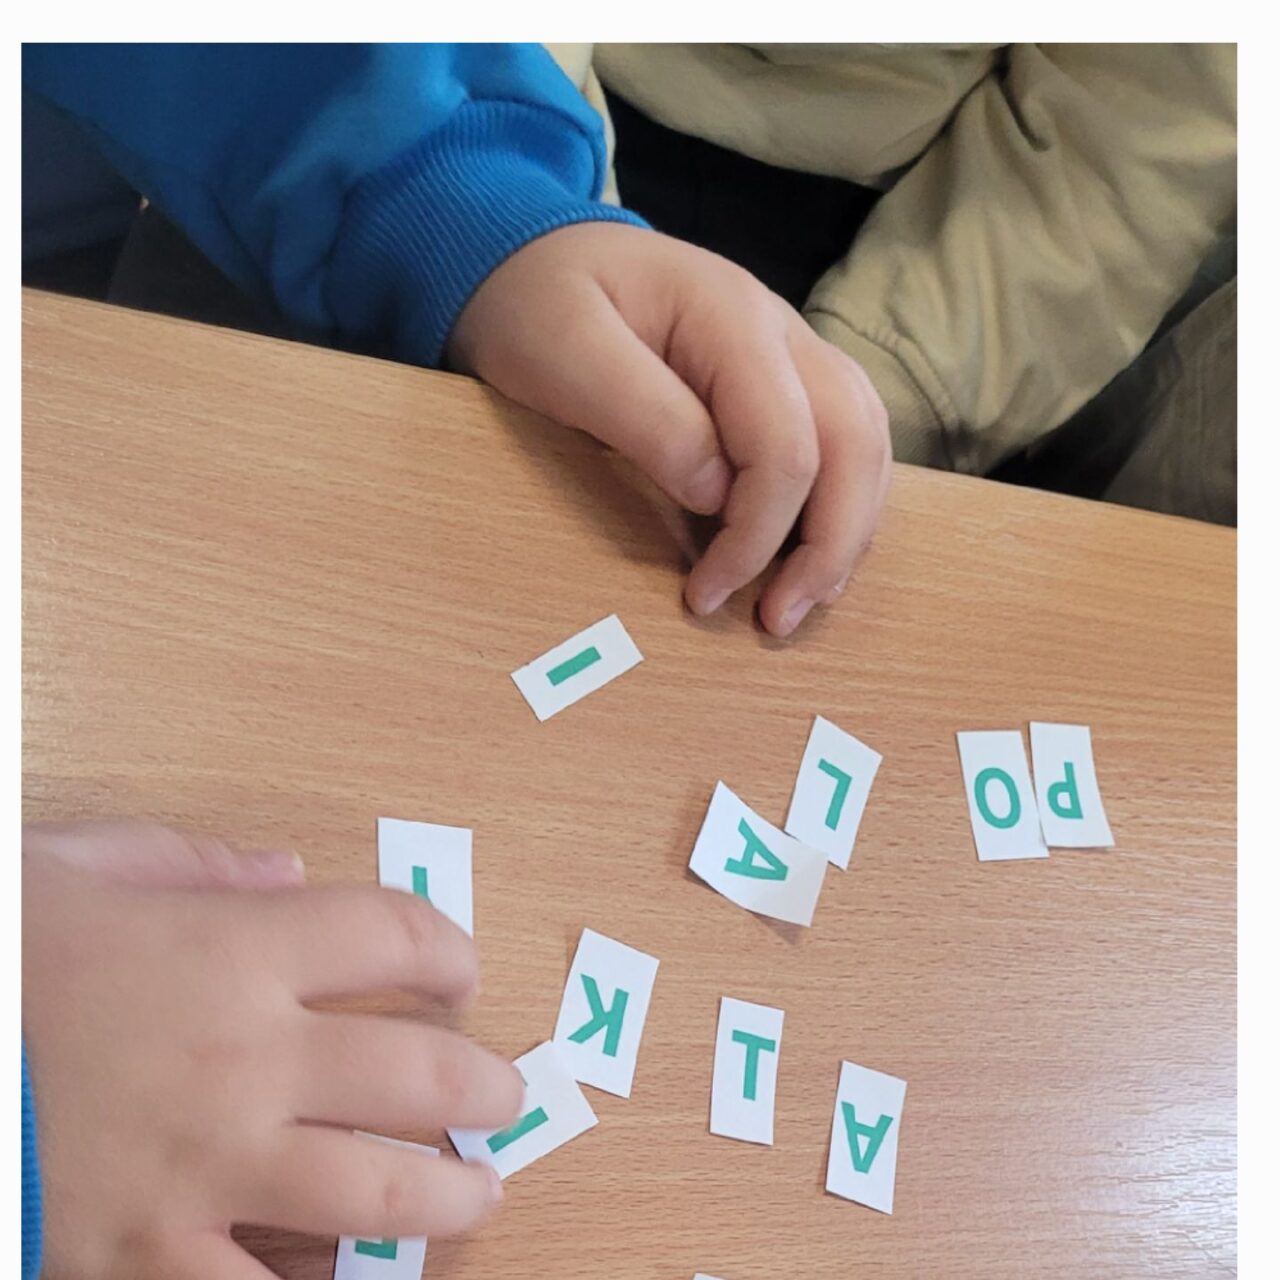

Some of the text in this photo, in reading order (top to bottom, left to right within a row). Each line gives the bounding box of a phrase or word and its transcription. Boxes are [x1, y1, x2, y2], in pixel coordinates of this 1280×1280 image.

[816, 758, 853, 830] L
[723, 817, 789, 882] A
[567, 973, 630, 1057] K
[731, 1029, 775, 1100] T
[840, 1101, 893, 1174] A
